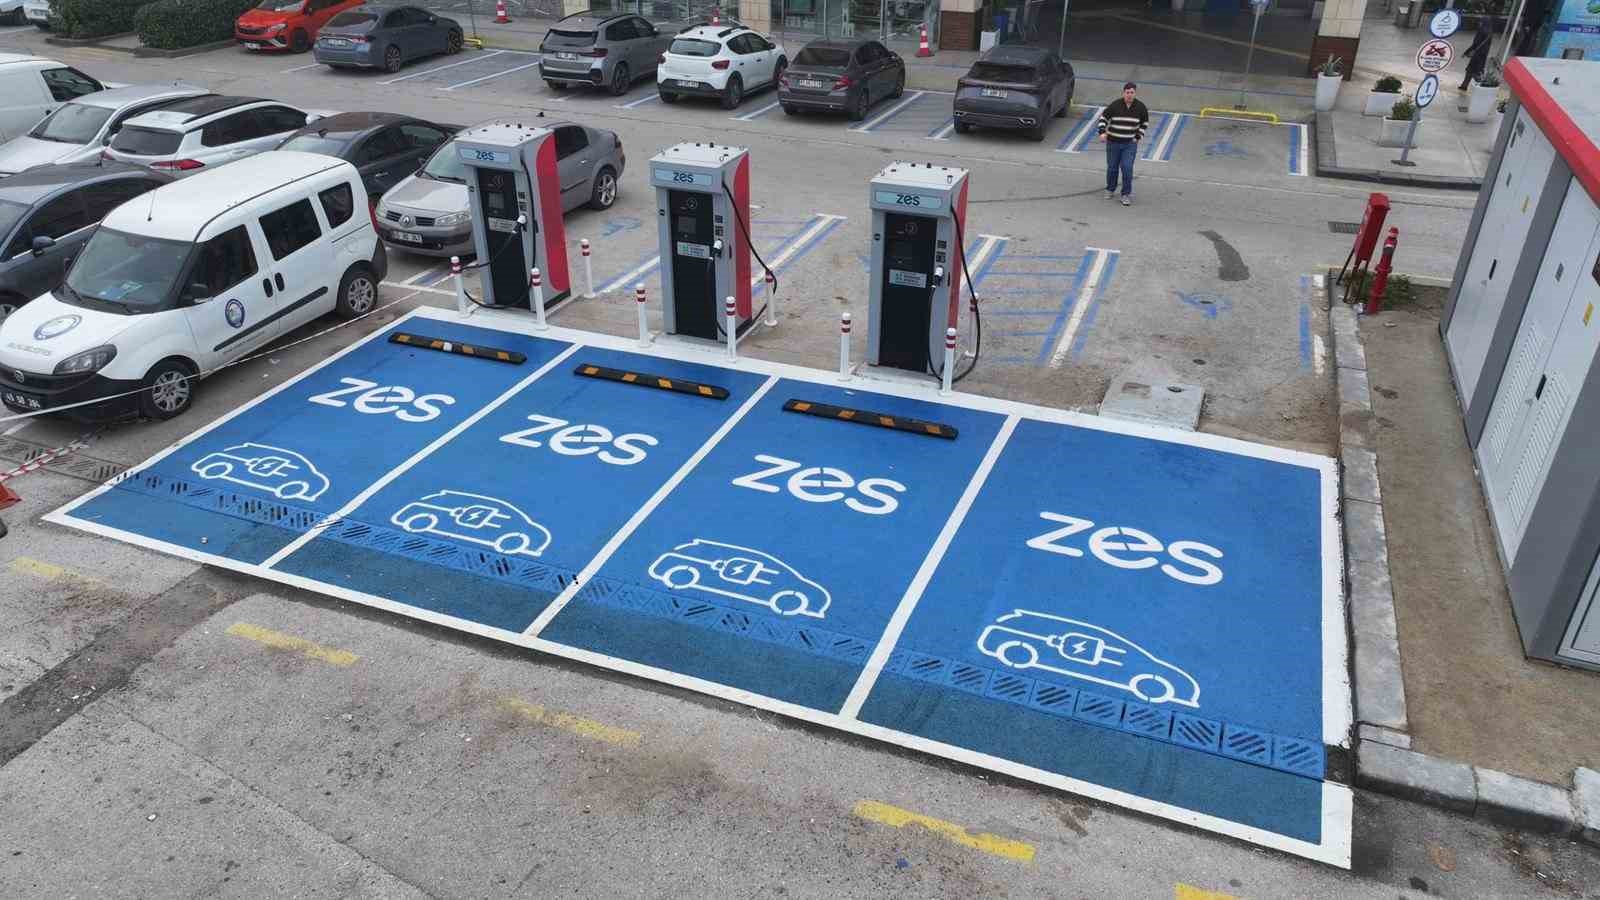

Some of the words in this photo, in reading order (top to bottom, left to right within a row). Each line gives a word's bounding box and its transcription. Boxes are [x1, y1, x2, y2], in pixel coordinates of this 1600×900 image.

[475, 150, 496, 161] zes
[672, 172, 694, 184] zes
[896, 193, 921, 206] zes
[308, 377, 456, 422] zes
[499, 414, 658, 465] zes
[732, 454, 906, 515] zes
[1026, 512, 1223, 585] zes
